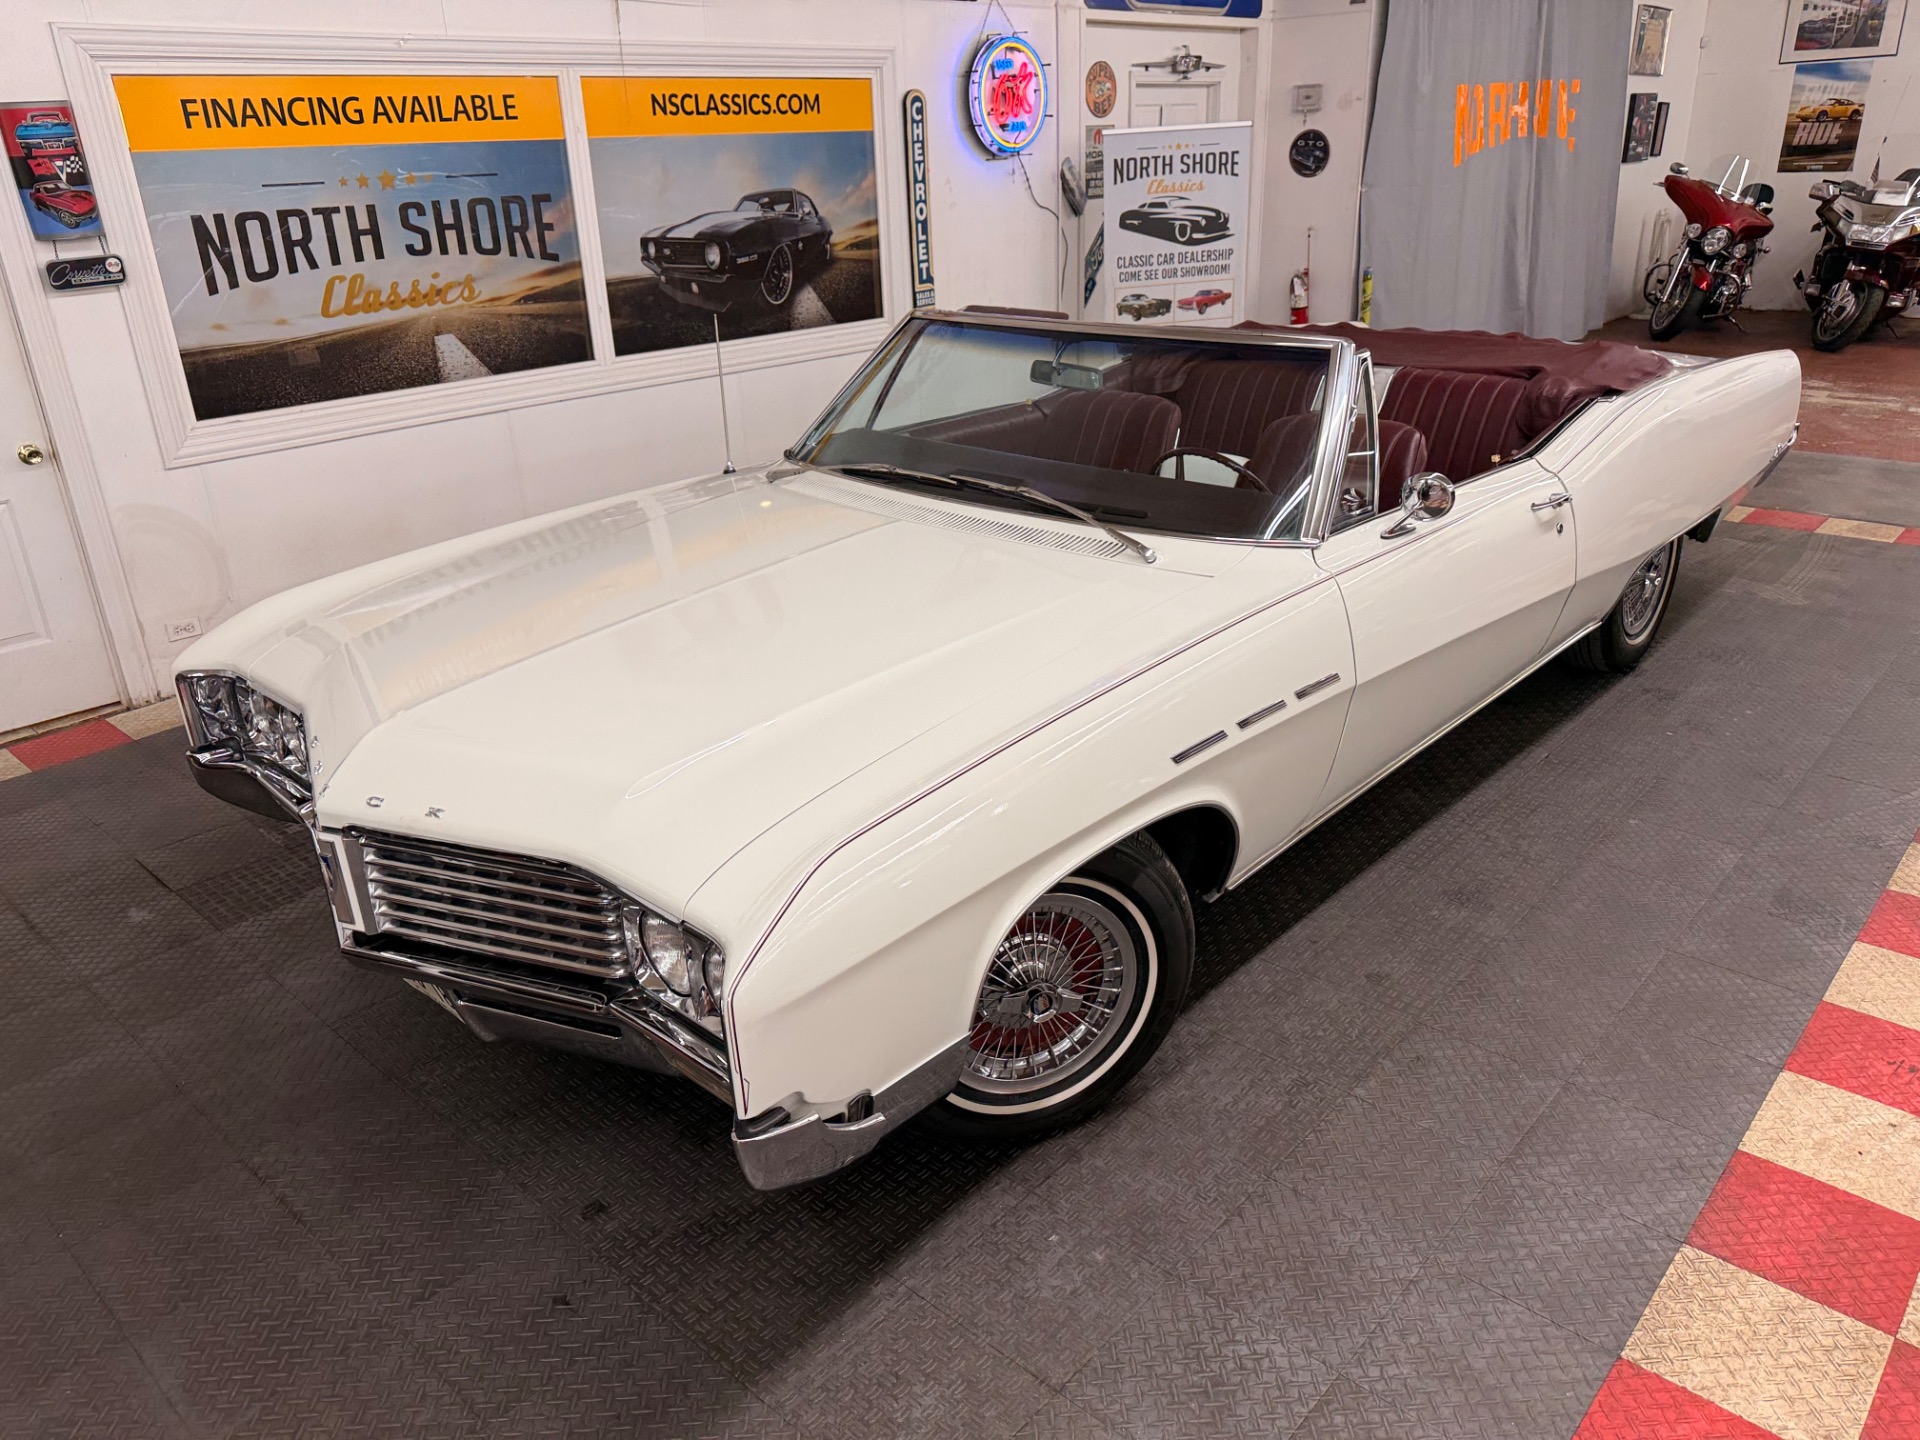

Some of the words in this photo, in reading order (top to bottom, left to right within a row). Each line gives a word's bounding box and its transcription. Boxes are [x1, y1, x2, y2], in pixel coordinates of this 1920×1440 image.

[650, 93, 821, 116] NSCLASSICS.COM
[993, 61, 1034, 125] OK
[1093, 94, 1113, 115] BEE
[180, 96, 363, 129] FINANCING
[372, 94, 518, 124] AVAILABLE
[1792, 121, 1844, 146] RIDE
[1113, 154, 1174, 186] NORTH
[1180, 149, 1240, 178] SHORE
[911, 102, 928, 280] CHEVROLET
[1147, 178, 1205, 194] Classics
[190, 204, 385, 297] NORTH
[399, 193, 561, 262] SHORE
[1116, 253, 1155, 270] CLASSIC
[1157, 251, 1176, 266] CAR
[1177, 248, 1235, 264] DEALERSHIP
[50, 263, 106, 286] Corvette
[1118, 268, 1142, 283] COME
[1144, 267, 1160, 281] SEE
[1162, 266, 1178, 279] OUR
[1180, 263, 1231, 278] SHOWROOM!
[321, 271, 483, 320] Classics
